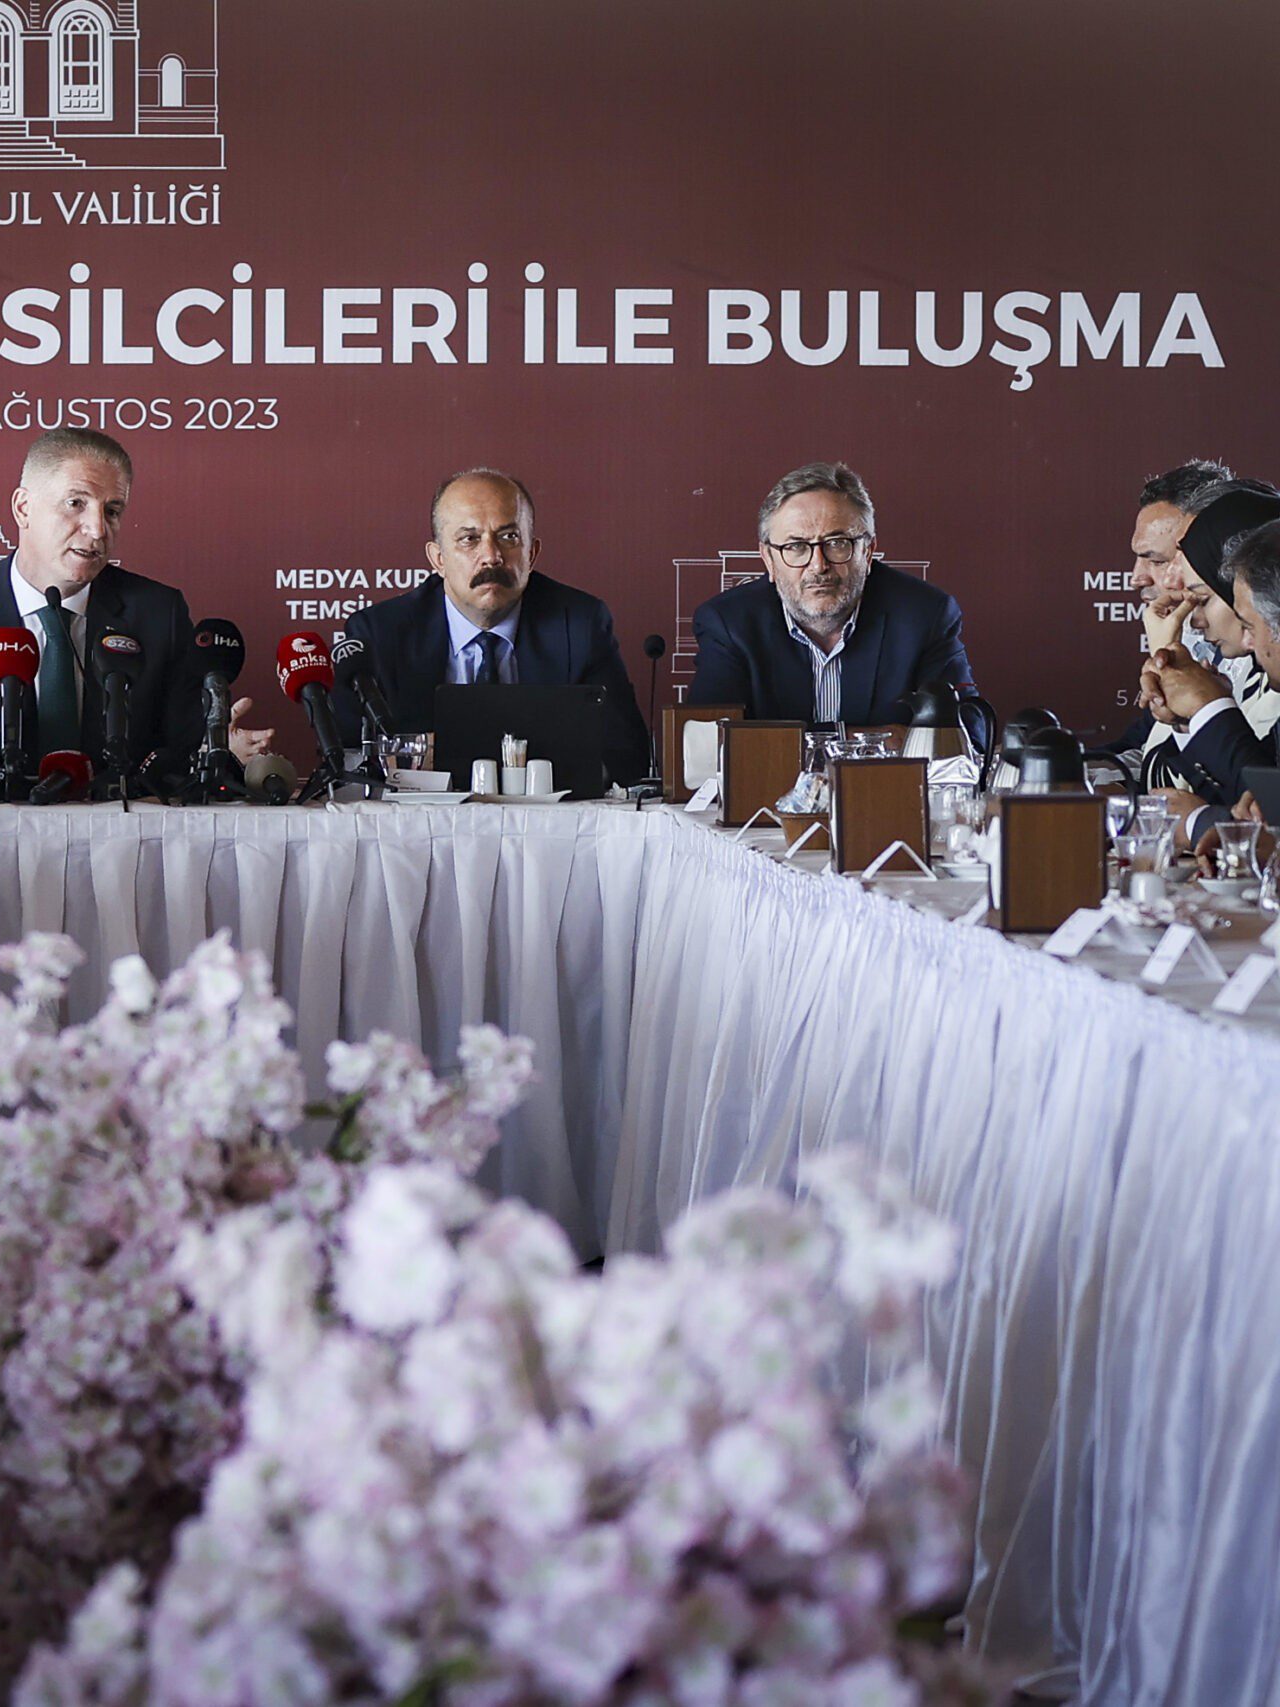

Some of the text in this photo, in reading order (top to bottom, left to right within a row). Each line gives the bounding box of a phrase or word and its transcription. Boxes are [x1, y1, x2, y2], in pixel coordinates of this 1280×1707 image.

[52, 183, 221, 225] VALİLİĞİ
[524, 262, 674, 364] İLE
[708, 289, 1226, 392] BULUŞMA
[184, 398, 279, 430] 2023
[276, 568, 370, 589] MEDYA
[289, 652, 327, 668] anka
